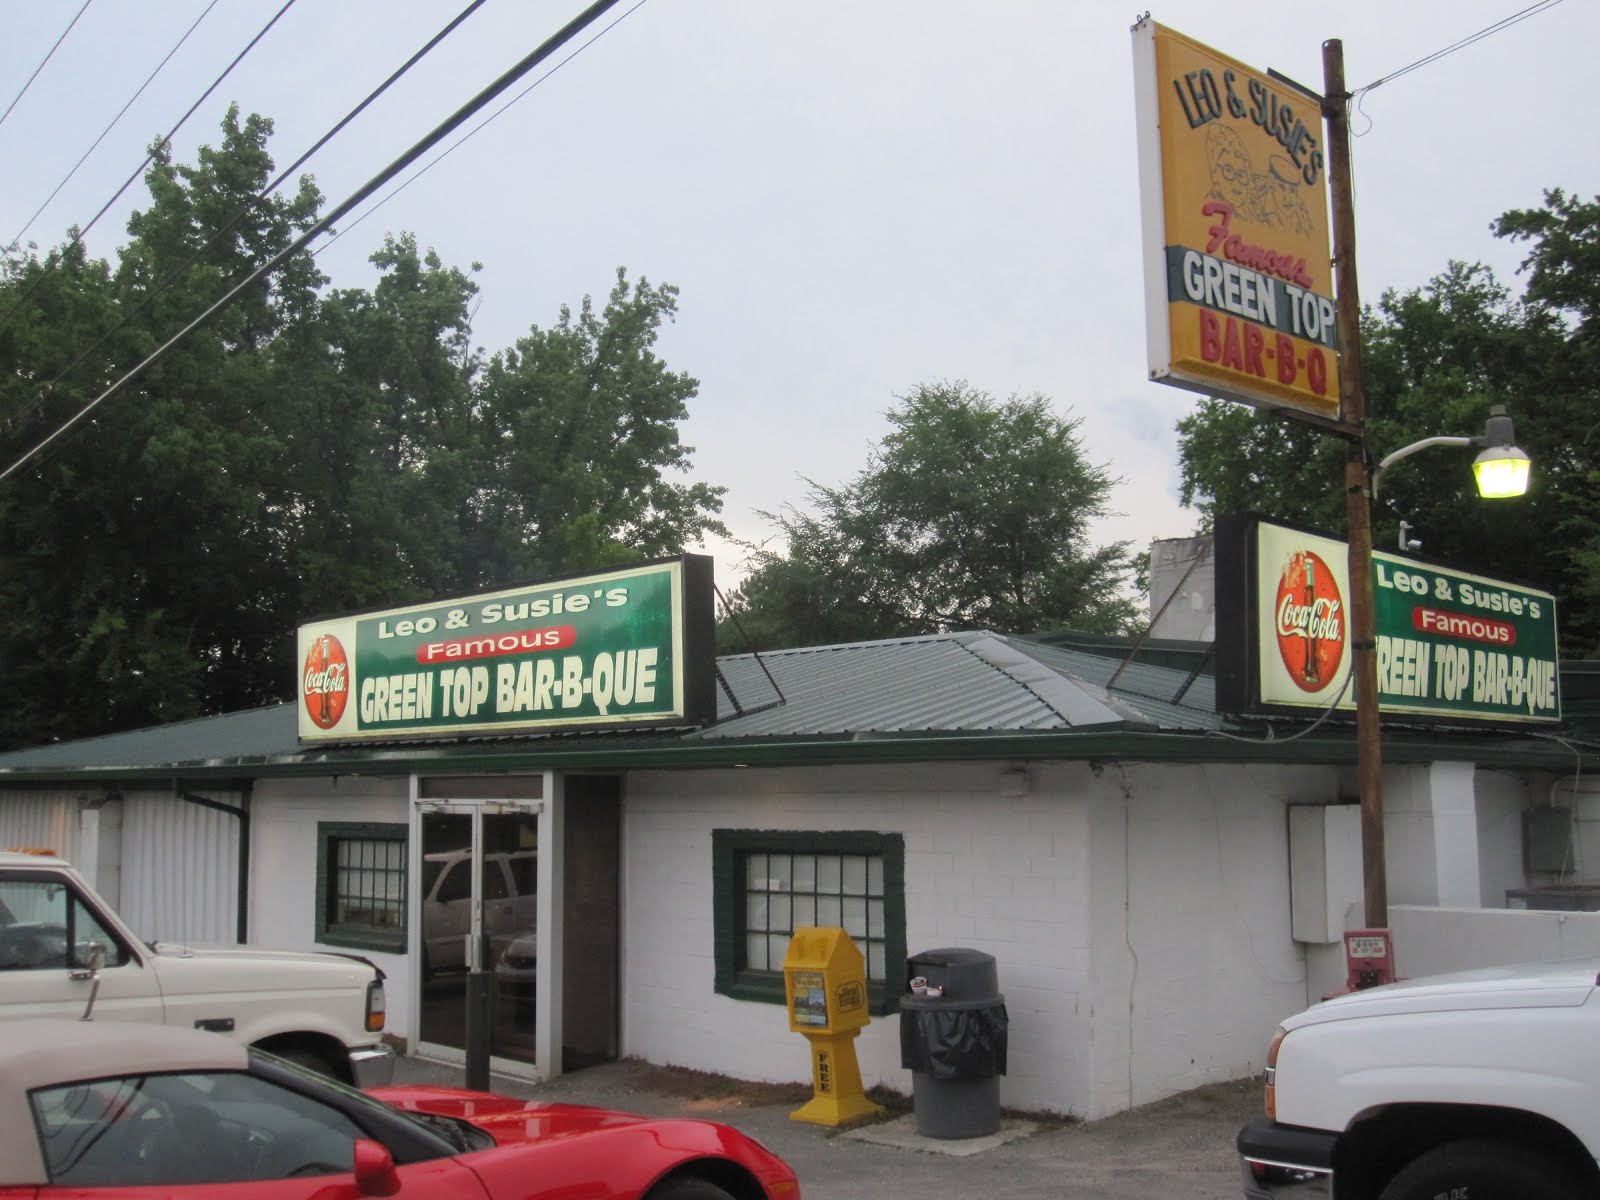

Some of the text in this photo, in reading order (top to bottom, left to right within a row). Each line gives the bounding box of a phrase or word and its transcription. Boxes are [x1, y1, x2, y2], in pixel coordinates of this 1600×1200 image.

[1174, 68, 1323, 186] LEO & SUSIE'S
[1202, 201, 1314, 289] Famous
[1183, 250, 1334, 344] GREEN TOP
[1200, 308, 1327, 396] BAR-B-Q
[379, 587, 629, 639] Leo & Susie's
[1277, 593, 1341, 641] Coca-Cola
[1376, 564, 1541, 619] Leo & Susie's
[426, 629, 560, 660] Famous
[1422, 612, 1509, 642] Famous
[304, 663, 346, 695] Coca-Cola
[360, 647, 659, 724] GREEN TOP BAR-B-QUE
[1376, 635, 1556, 715] REEN TOP BAR-B-QUE
[819, 1053, 830, 1092] FREE
